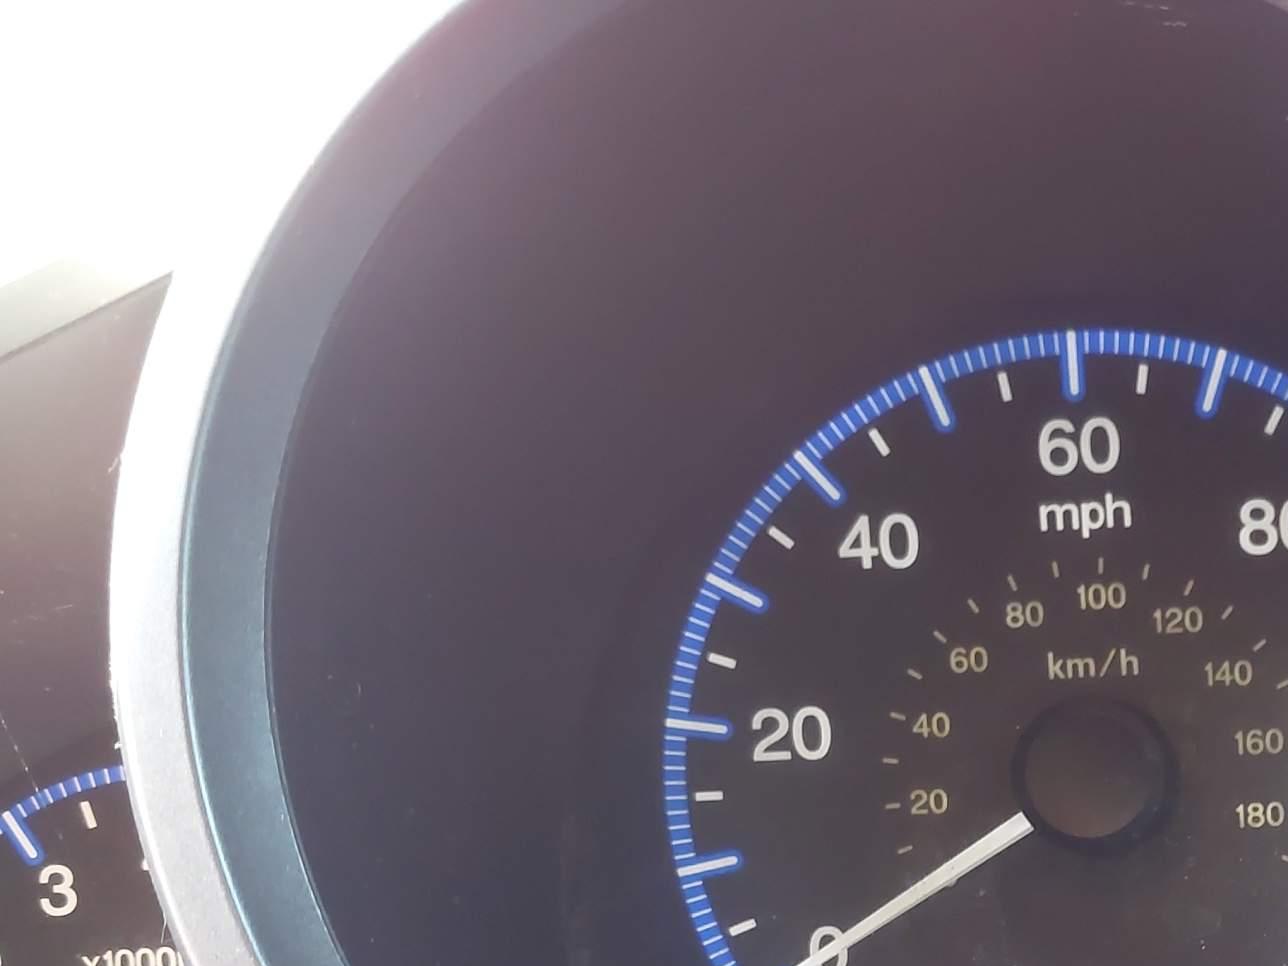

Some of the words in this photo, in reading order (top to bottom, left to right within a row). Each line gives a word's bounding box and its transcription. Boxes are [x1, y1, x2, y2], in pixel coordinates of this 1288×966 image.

[1038, 416, 1120, 476] 60
[1039, 492, 1132, 539] mph
[838, 512, 919, 570] 40
[1076, 582, 1127, 610] 100
[1005, 600, 1044, 628] 80
[1152, 606, 1203, 633] 120
[949, 645, 988, 674] 60
[1047, 648, 1139, 680] km/h
[1204, 659, 1253, 687] 140
[751, 706, 832, 762] 20
[912, 712, 951, 738] 40
[1234, 728, 1284, 756] 160
[910, 789, 948, 815] 20
[1235, 801, 1285, 829] 180
[39, 864, 78, 917] 3
